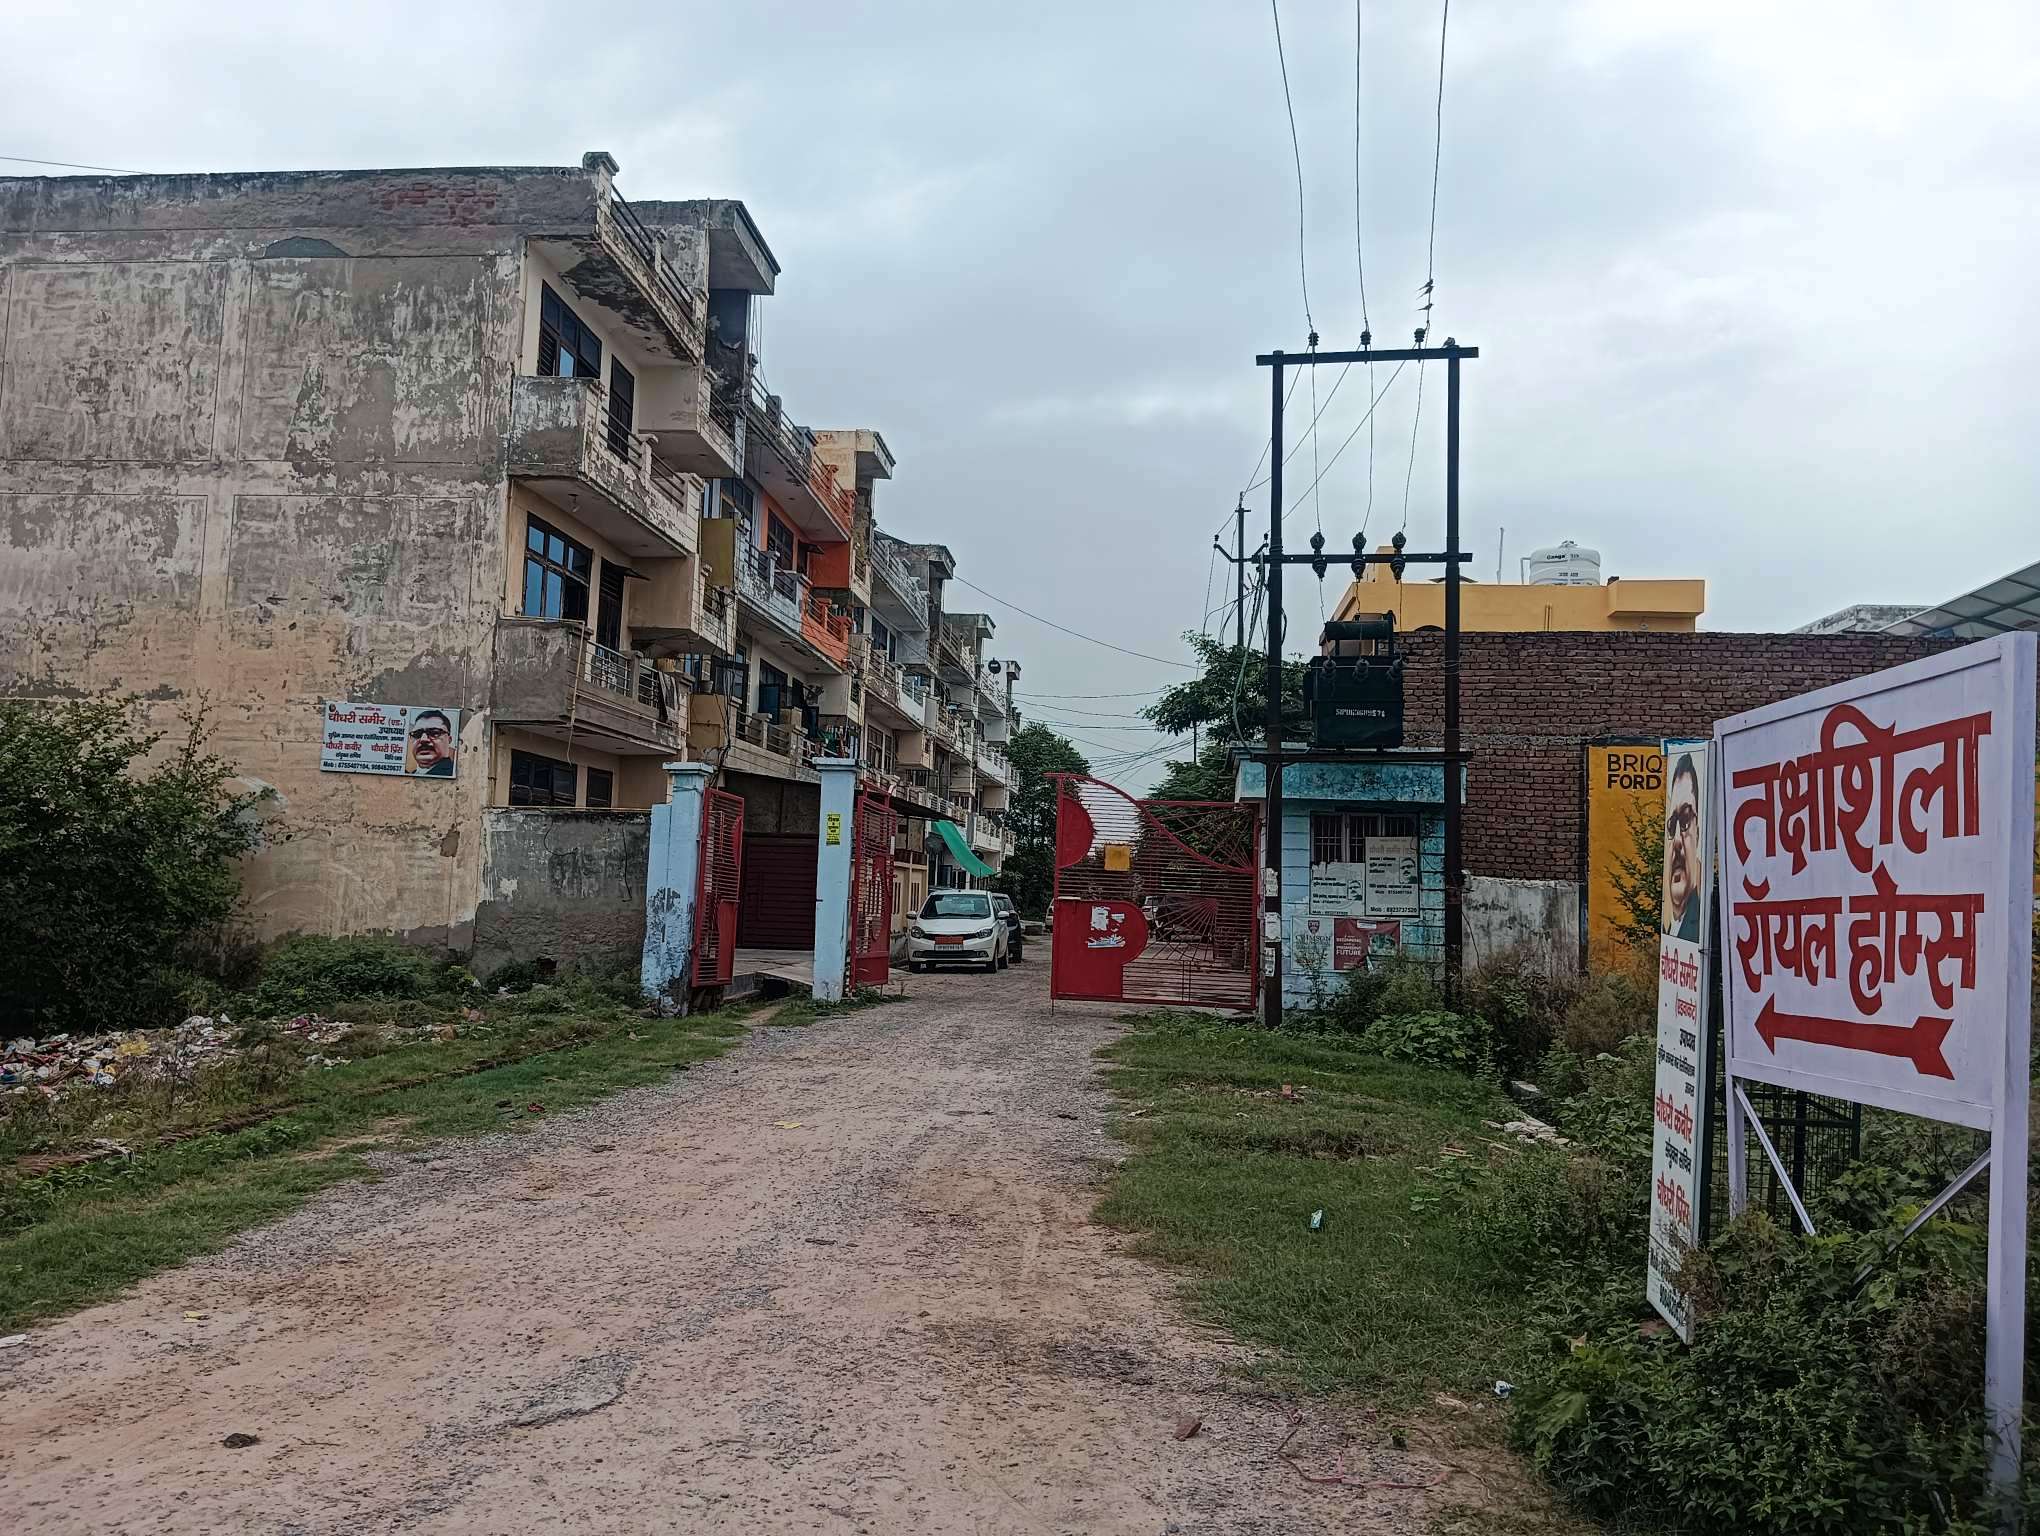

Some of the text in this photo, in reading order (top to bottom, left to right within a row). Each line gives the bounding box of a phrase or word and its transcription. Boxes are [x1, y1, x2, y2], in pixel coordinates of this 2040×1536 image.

[328, 710, 356, 724] चौधरी
[1607, 753, 1663, 773] BRIQ
[1607, 773, 1662, 790] FORD
[1732, 704, 1992, 876] तक्षशिला
[1734, 861, 1985, 1016] रॉयल होम्स
[1661, 945, 1699, 993] चौधरी समीर
[1656, 1088, 1673, 1130] चौधरी
[1657, 1170, 1675, 1215] चौधरी
